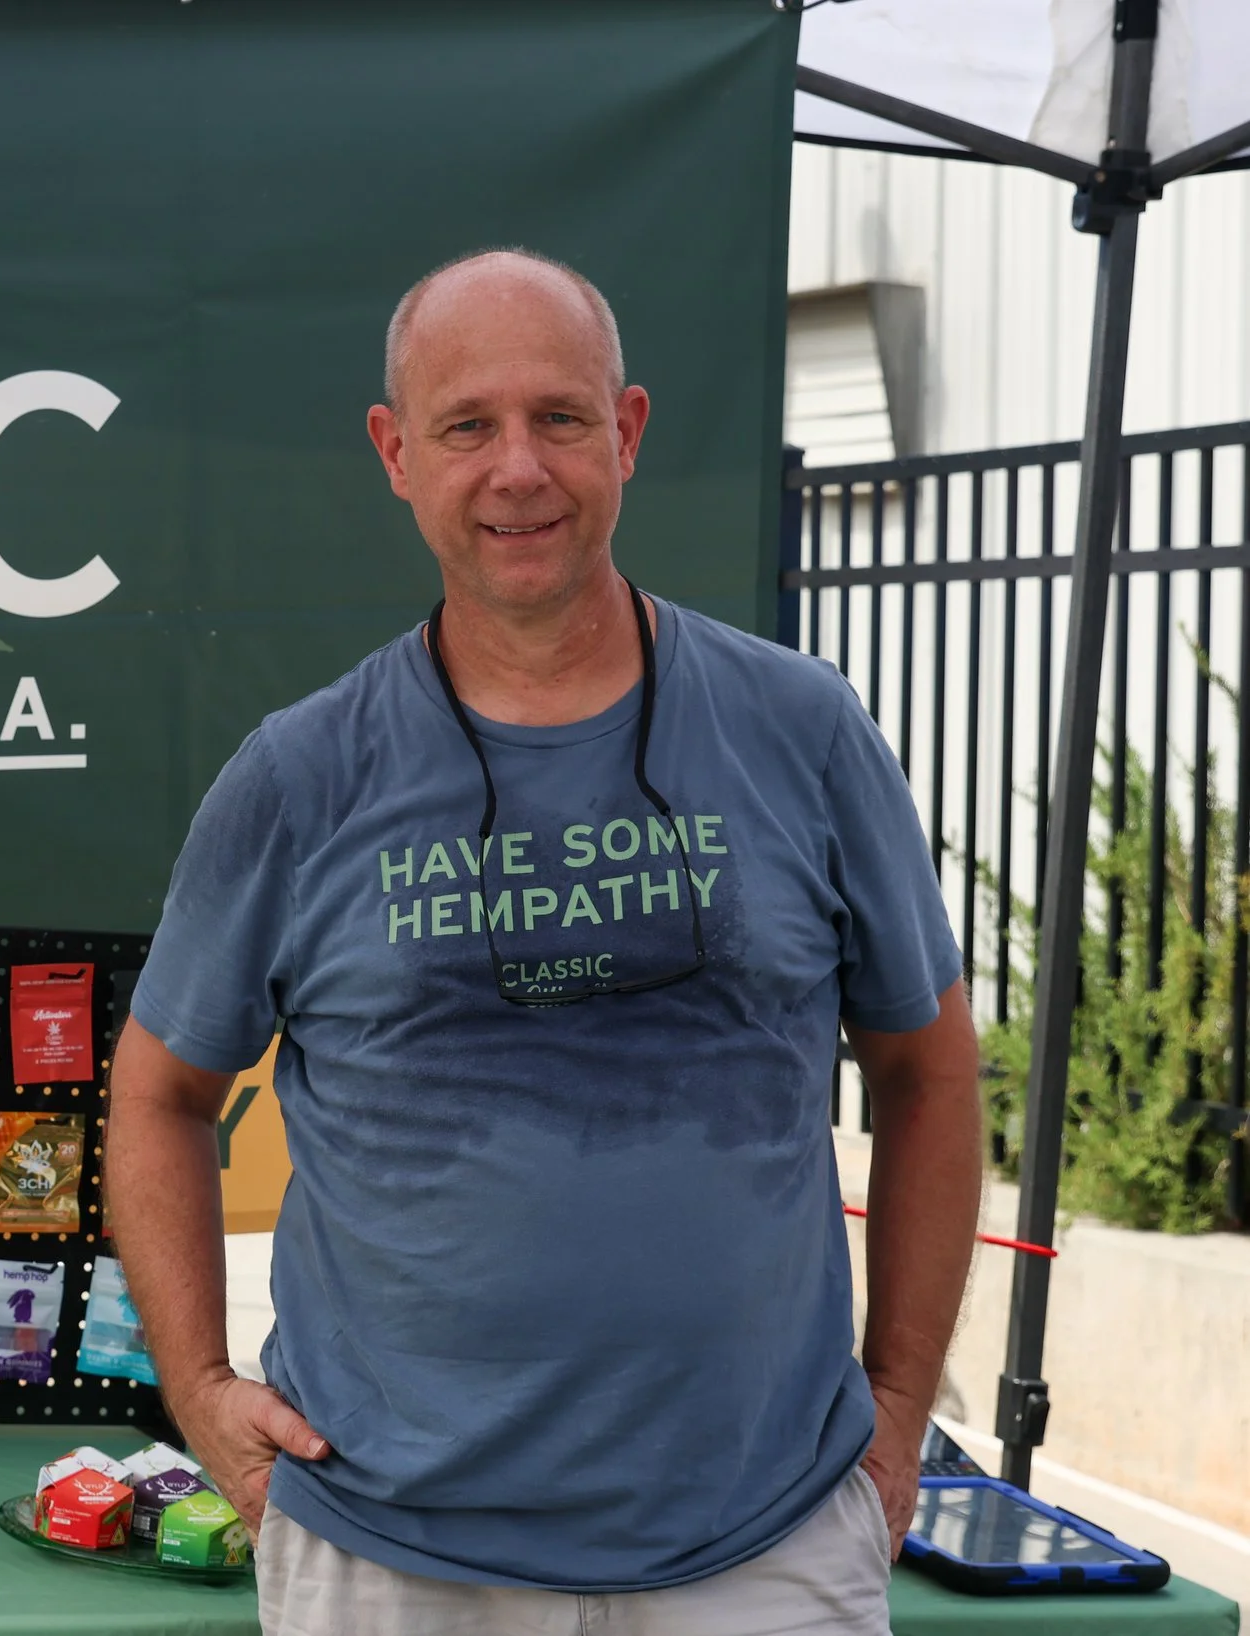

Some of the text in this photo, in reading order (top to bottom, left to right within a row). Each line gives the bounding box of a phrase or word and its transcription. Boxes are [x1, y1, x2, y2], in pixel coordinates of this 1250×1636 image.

[380, 815, 728, 893] HAVE SOME
[388, 868, 720, 944] HEMPATHY
[502, 953, 613, 988] CLASSIC
[61, 1145, 76, 1155] 20
[3, 1269, 29, 1284] hemp
